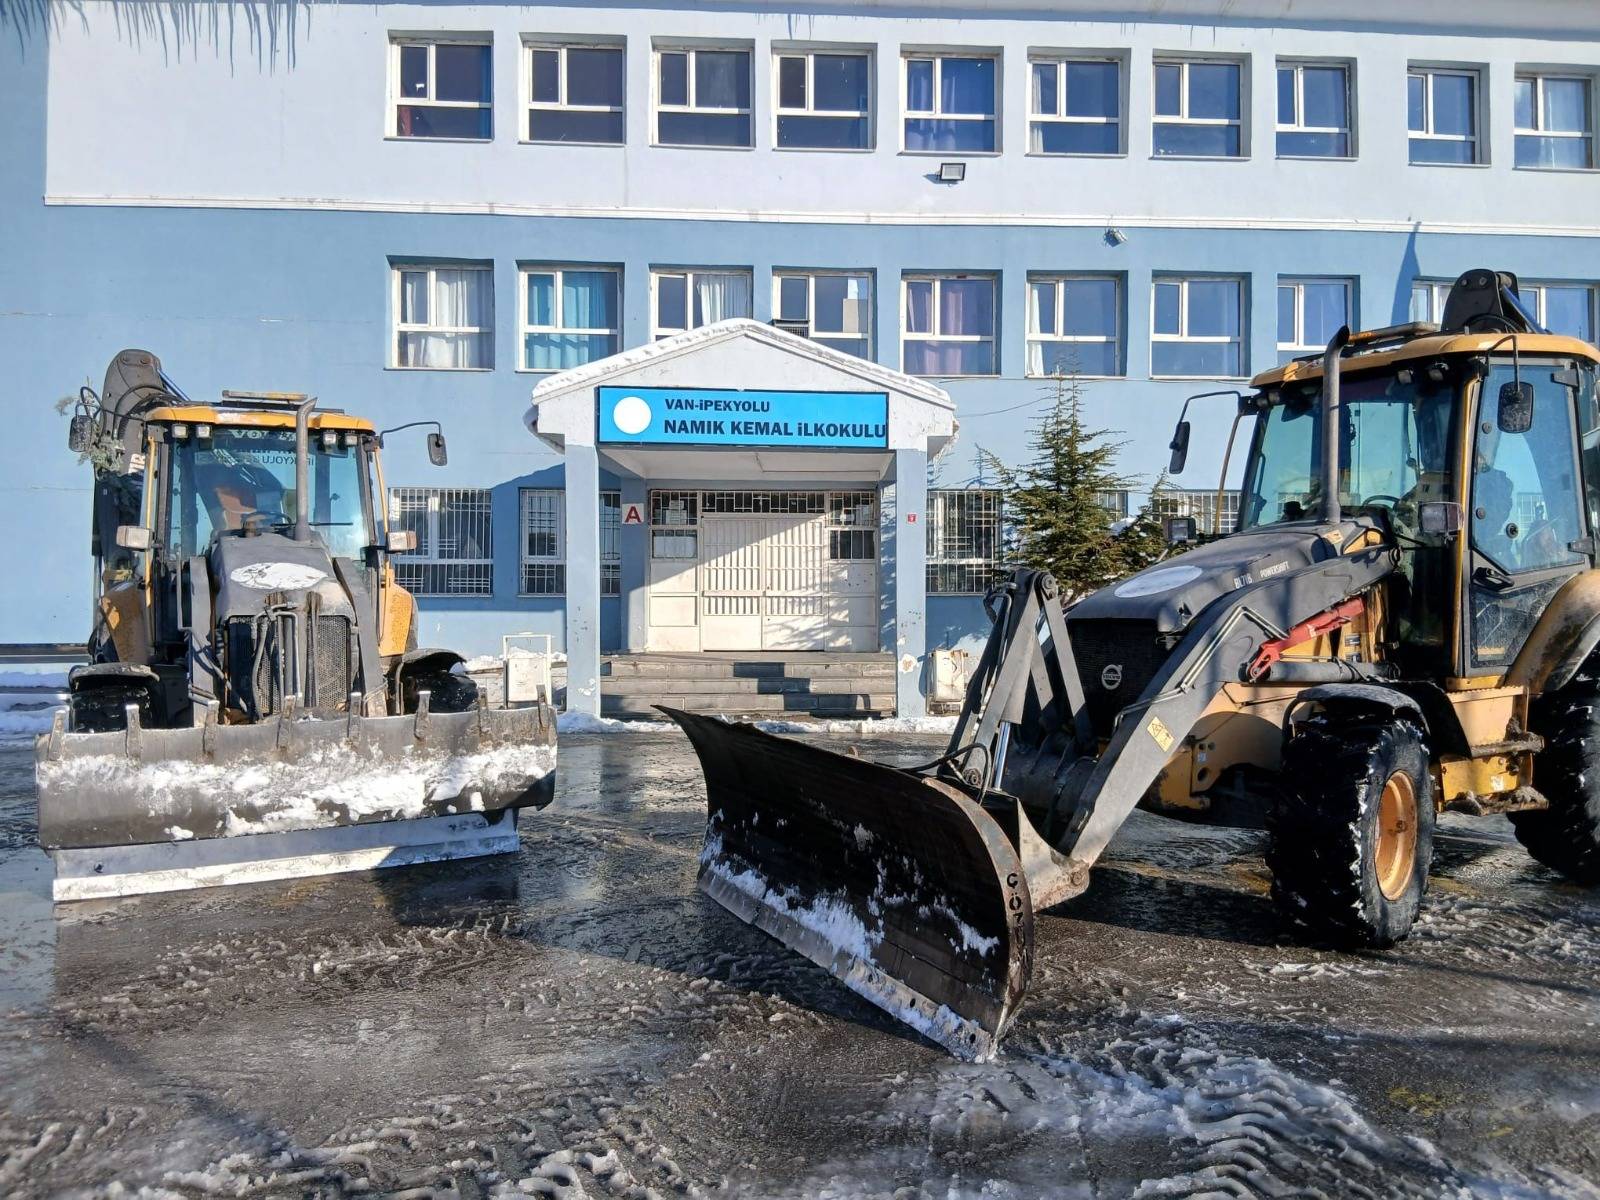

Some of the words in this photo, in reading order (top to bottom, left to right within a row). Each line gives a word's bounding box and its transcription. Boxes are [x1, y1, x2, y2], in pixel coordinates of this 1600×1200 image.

[664, 419, 725, 434] NAMIK
[730, 421, 793, 436] KEMAL
[625, 505, 642, 523] A
